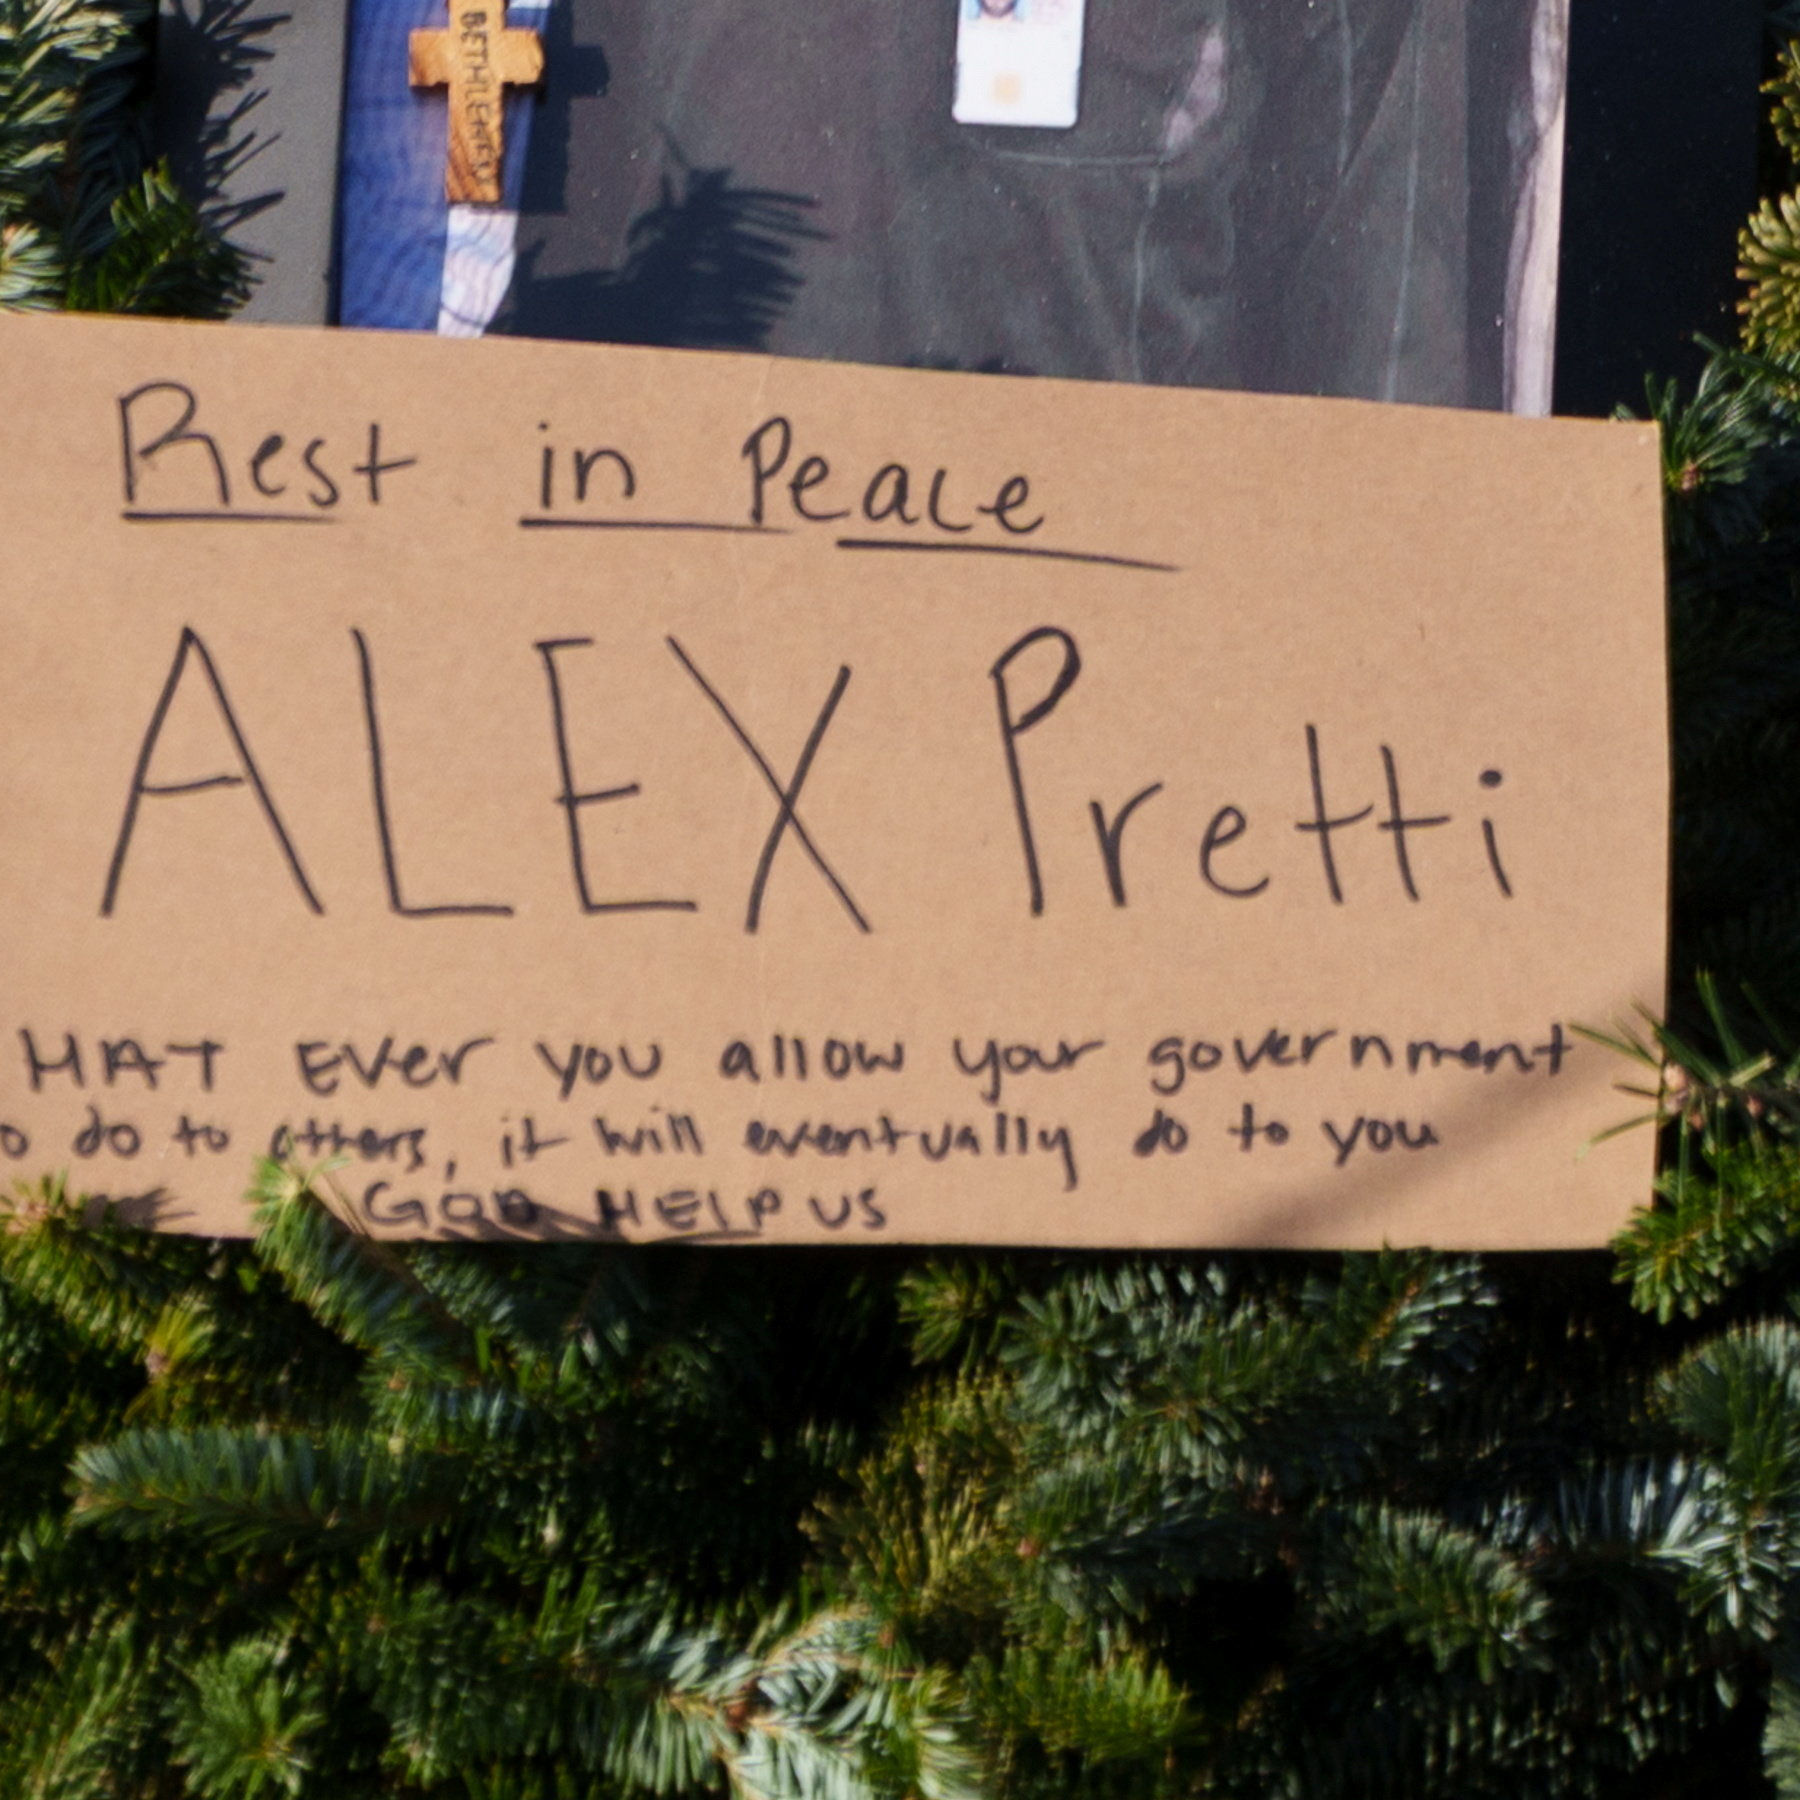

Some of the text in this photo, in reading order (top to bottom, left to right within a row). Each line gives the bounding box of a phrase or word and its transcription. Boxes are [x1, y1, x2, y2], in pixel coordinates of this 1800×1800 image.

[461, 11, 494, 184] BETHLEHEM
[116, 380, 1045, 536] Rest in Peace
[100, 624, 1513, 934] ALEX Pretti
[295, 1036, 496, 1097] Ever
[718, 1032, 905, 1084] allow
[953, 1036, 1106, 1107] your
[1147, 1022, 1576, 1096] government
[71, 1104, 142, 1160] do
[171, 1114, 231, 1156] to
[500, 1114, 572, 1168] it
[592, 1103, 703, 1156] will
[744, 1110, 1078, 1192] eventually
[1131, 1108, 1189, 1157] do
[1226, 1102, 1291, 1152] to
[1320, 1115, 1440, 1168] you
[362, 1180, 540, 1229] GOD
